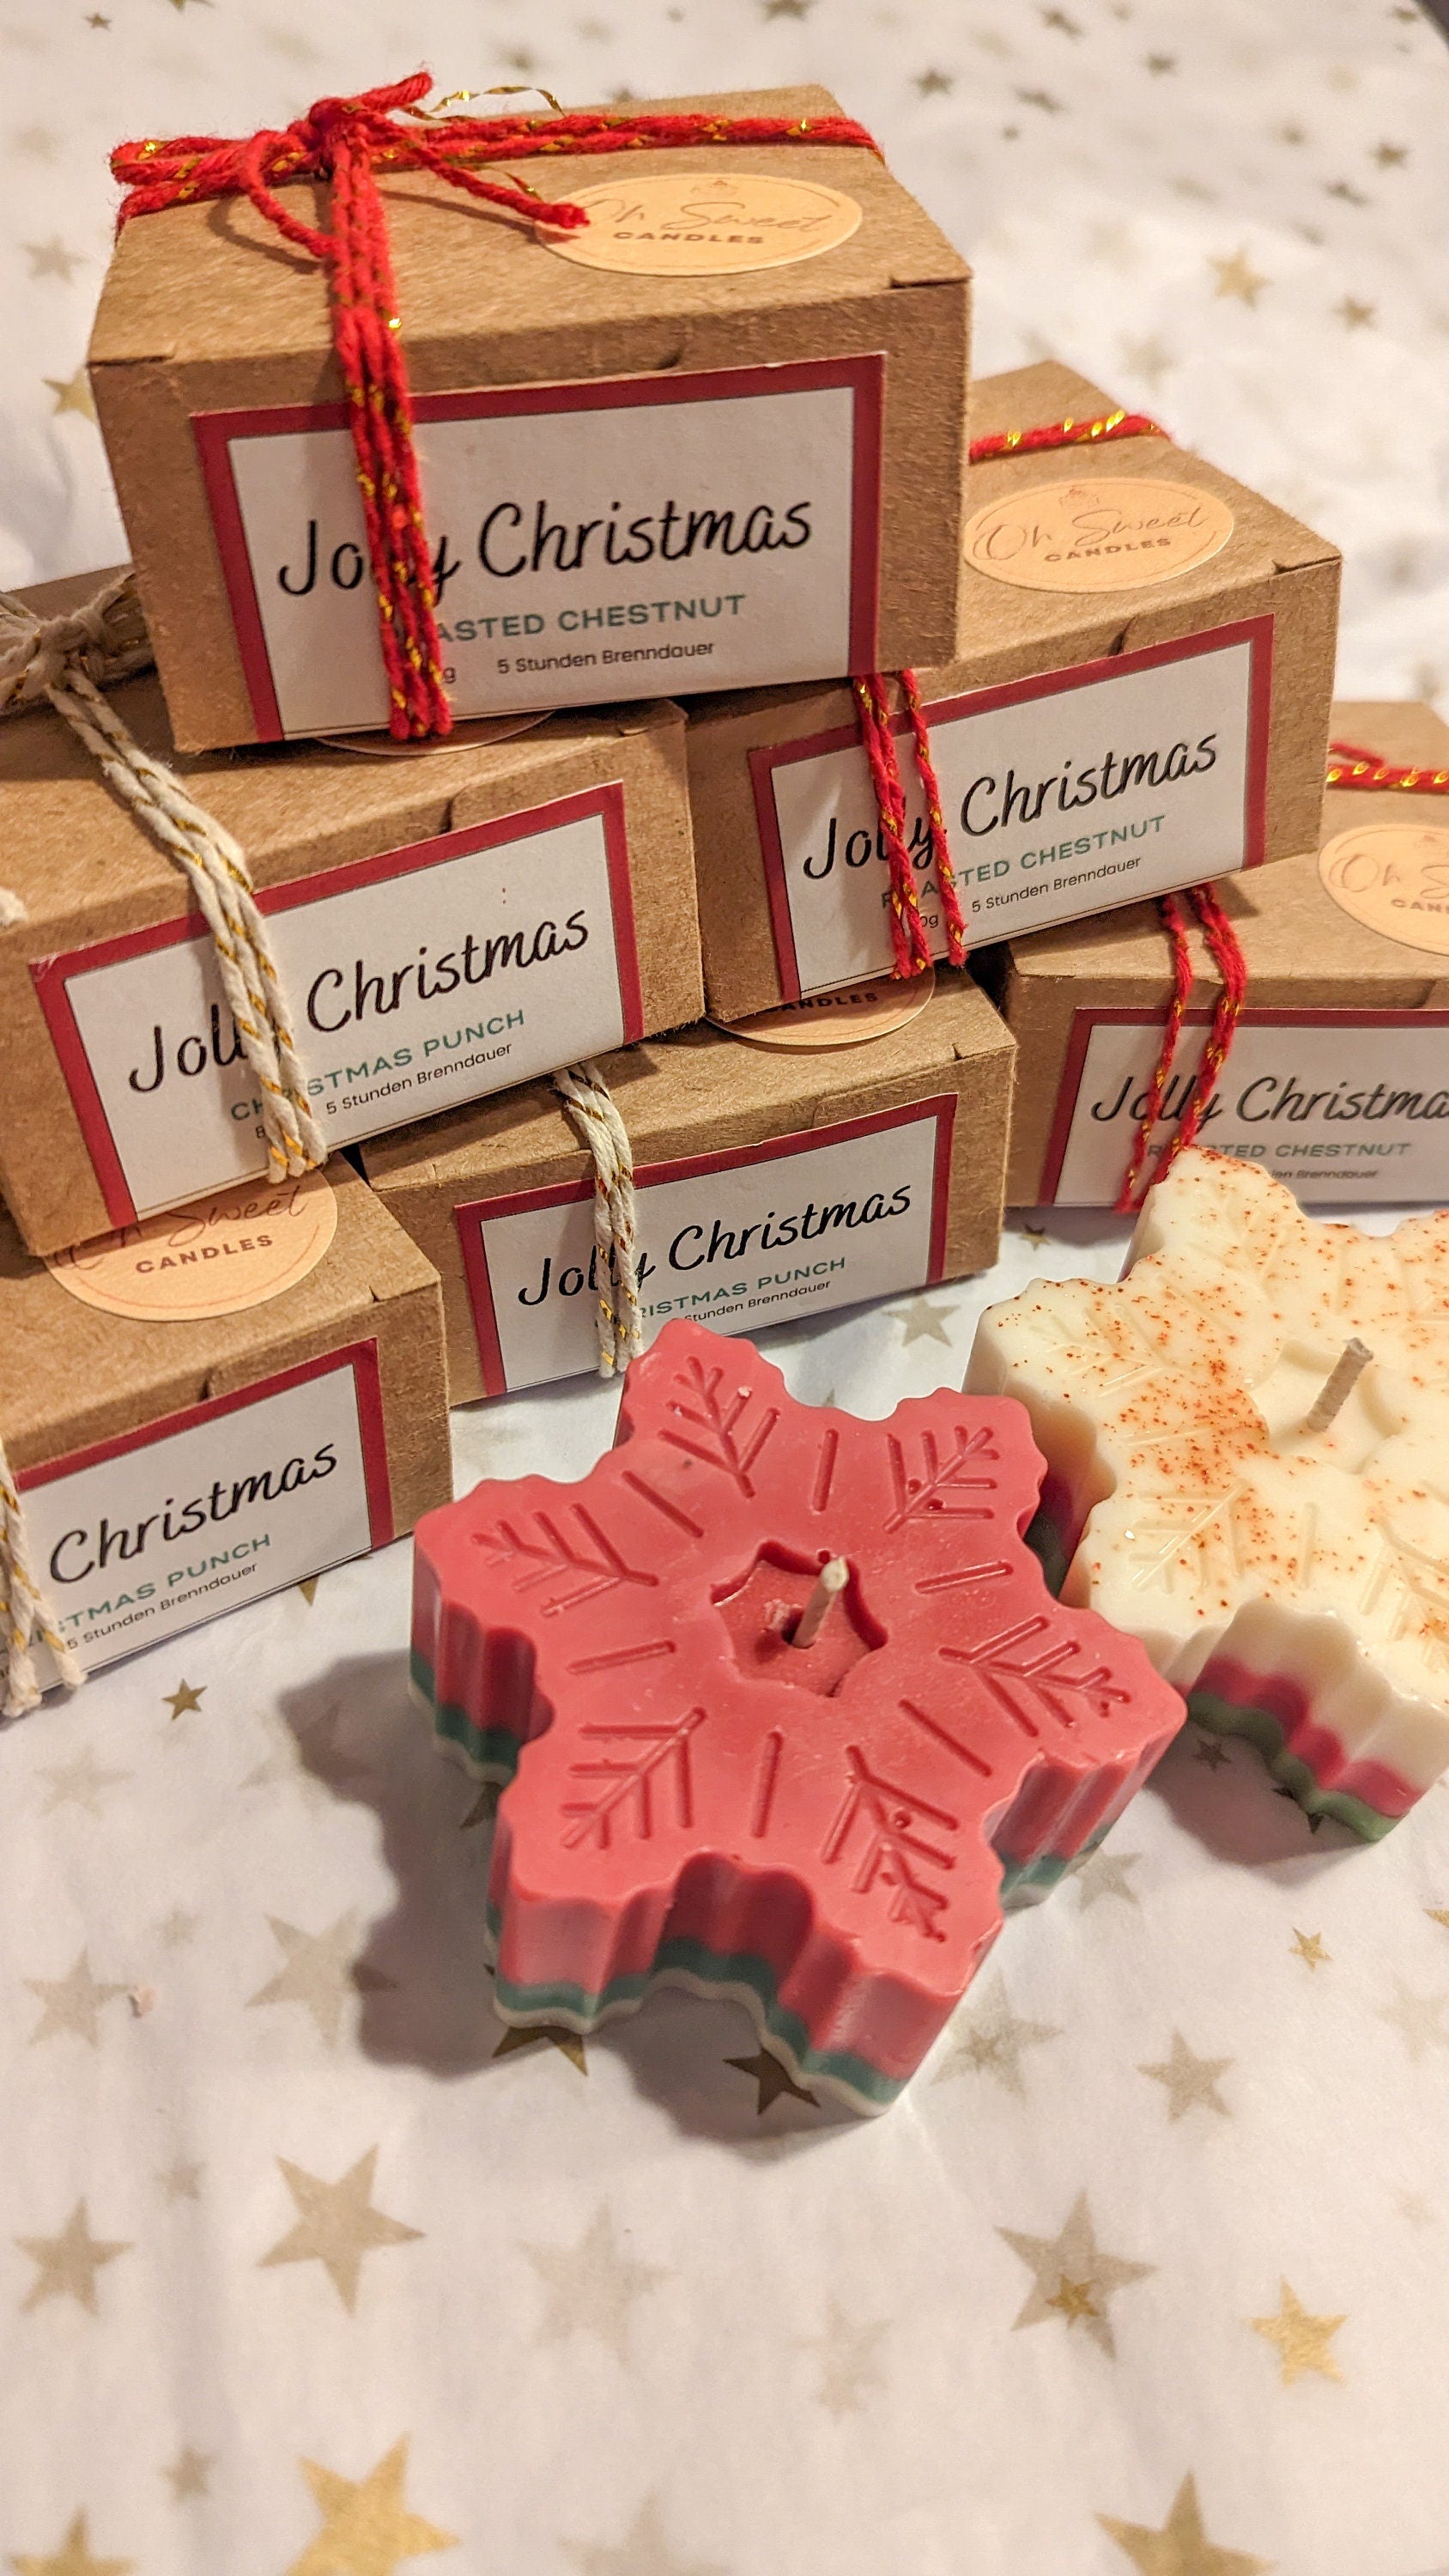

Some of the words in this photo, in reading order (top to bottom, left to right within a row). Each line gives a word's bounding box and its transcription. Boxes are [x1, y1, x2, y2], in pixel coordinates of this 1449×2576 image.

[613, 230, 765, 245] CANDLES
[661, 202, 832, 230] Sweet
[1044, 537, 1173, 562] CANDLES
[1072, 506, 1209, 547] Sweet
[277, 519, 461, 607] Joy
[478, 500, 812, 578] Christmas
[436, 613, 546, 642] ASTED
[557, 594, 747, 632] CHESTNUT
[497, 659, 510, 674] 5
[516, 652, 597, 673] Stunden
[602, 641, 715, 665] Brenndauer
[961, 733, 1218, 837] Christmas
[1020, 815, 1166, 871] CHESTNUT
[971, 900, 982, 914] 5
[985, 883, 1049, 908] Stunden
[1052, 856, 1143, 890] Brenndauer
[306, 910, 588, 1034] Christmas
[770, 993, 878, 1012] ANDLES
[423, 1009, 526, 1059] PUNCH
[326, 1101, 337, 1115] 5
[342, 1077, 413, 1111] Stunden
[417, 1042, 513, 1085] Brenndauer
[1236, 1077, 1449, 1122] Christma
[1275, 1143, 1412, 1157] CHESTNUT
[1296, 1170, 1379, 1180] Brenndauer
[669, 1184, 912, 1271] Christmas
[136, 1235, 274, 1273] CANDLES
[758, 1257, 846, 1290] PUNCH
[748, 1279, 831, 1309] Brenndauer
[50, 1443, 337, 1585] Christmas
[167, 1534, 271, 1588] PUNCH
[83, 1607, 155, 1643] Stunden
[160, 1564, 258, 1610] Brenndauer
